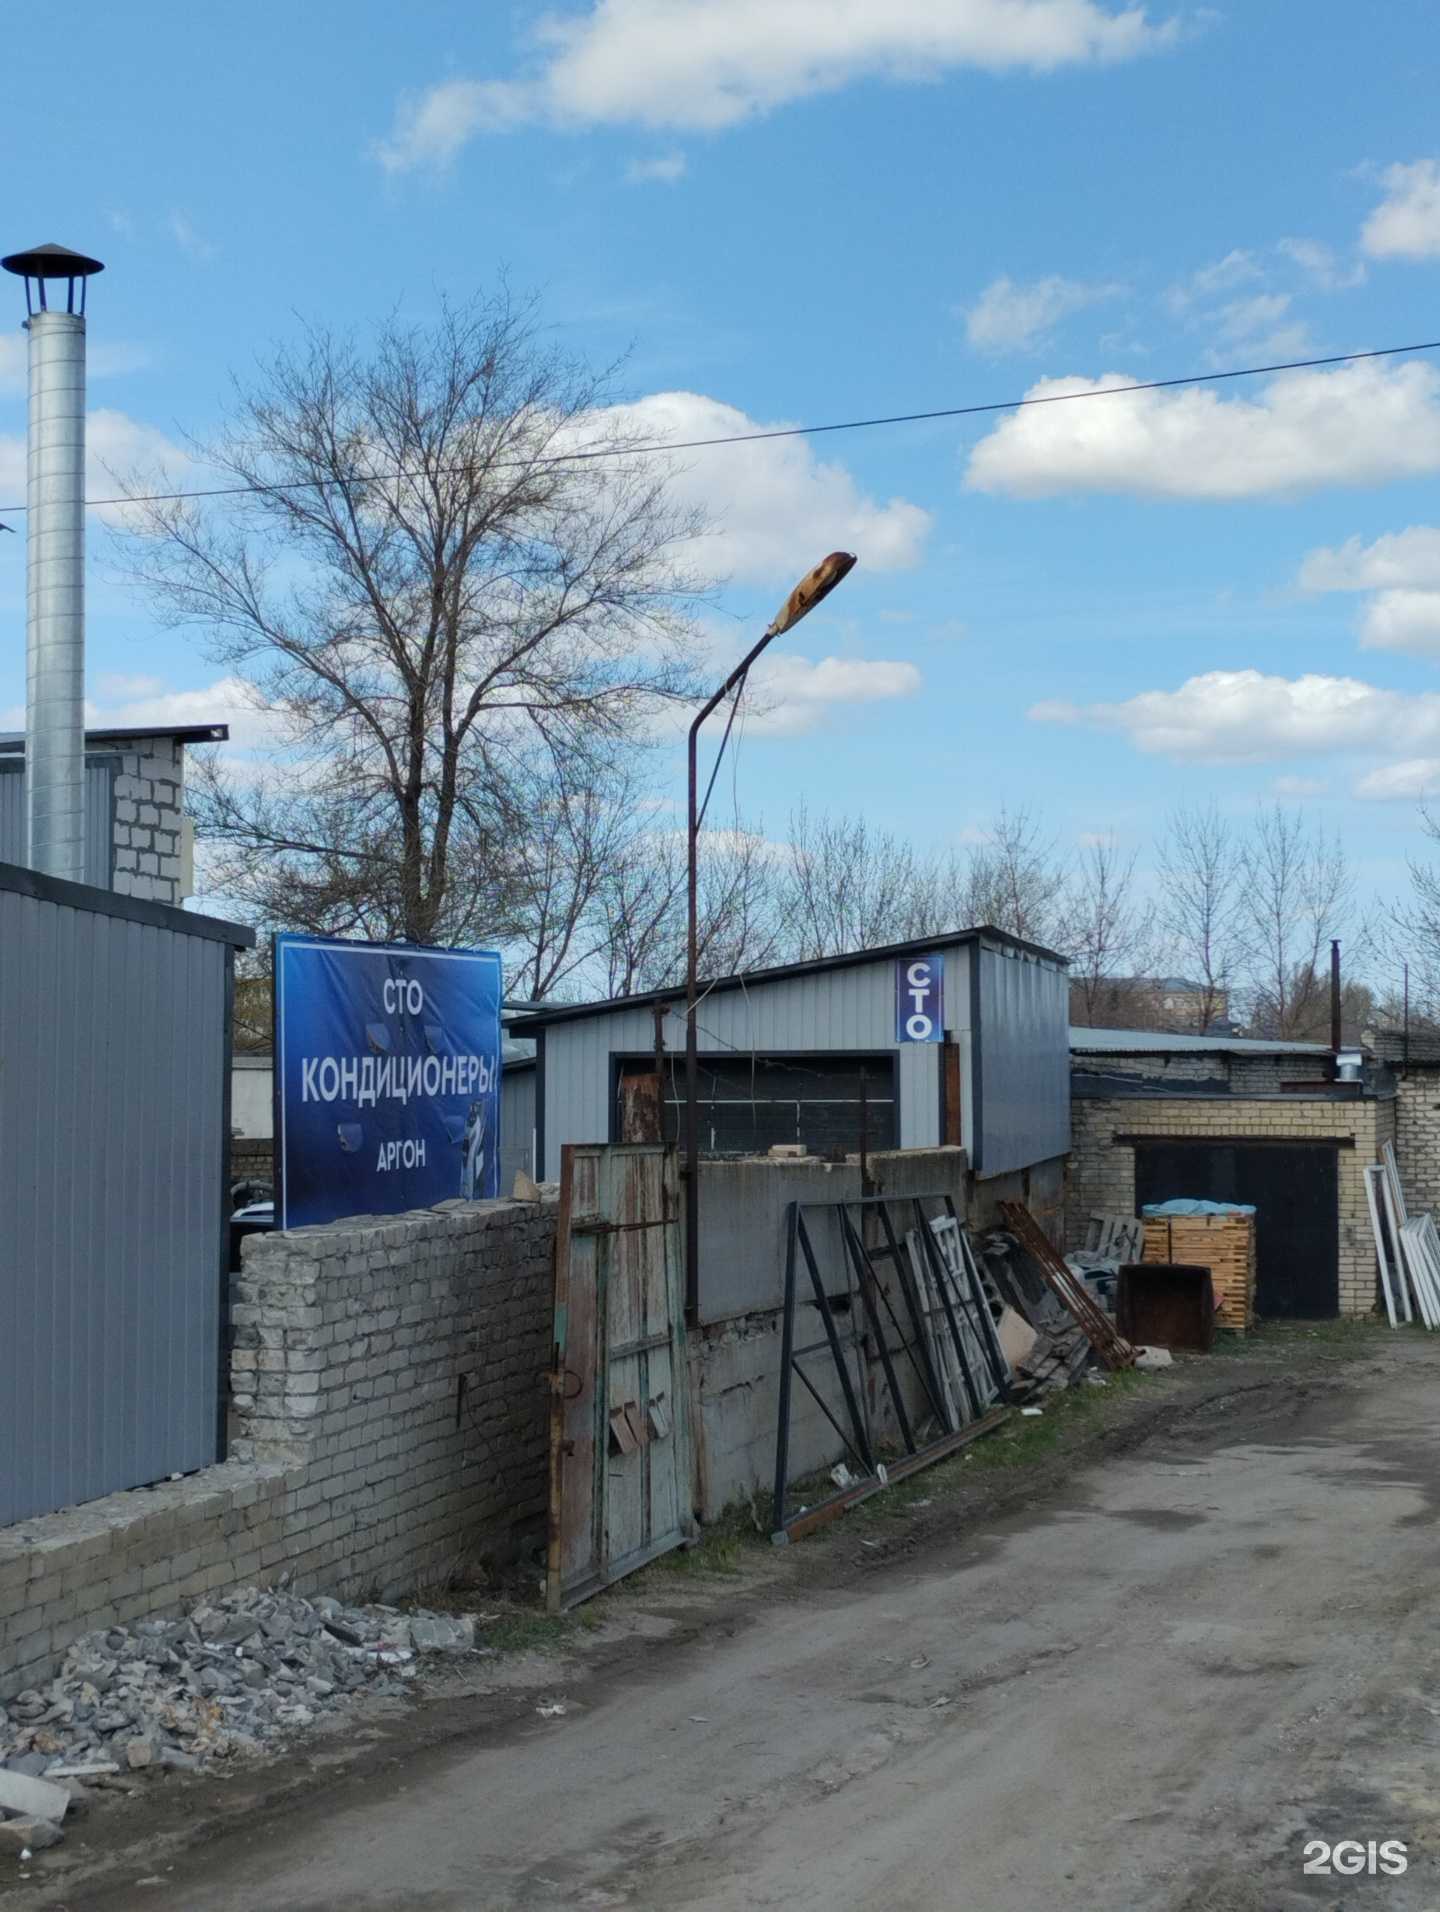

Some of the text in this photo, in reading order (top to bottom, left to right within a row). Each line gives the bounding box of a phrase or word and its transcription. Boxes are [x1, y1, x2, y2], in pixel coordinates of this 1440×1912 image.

[383, 978, 423, 1015] СТО
[906, 962, 932, 1039] СТО
[302, 1055, 495, 1108] КОНДИЦИОНЕРЫ
[376, 1139, 426, 1172] АРГОН
